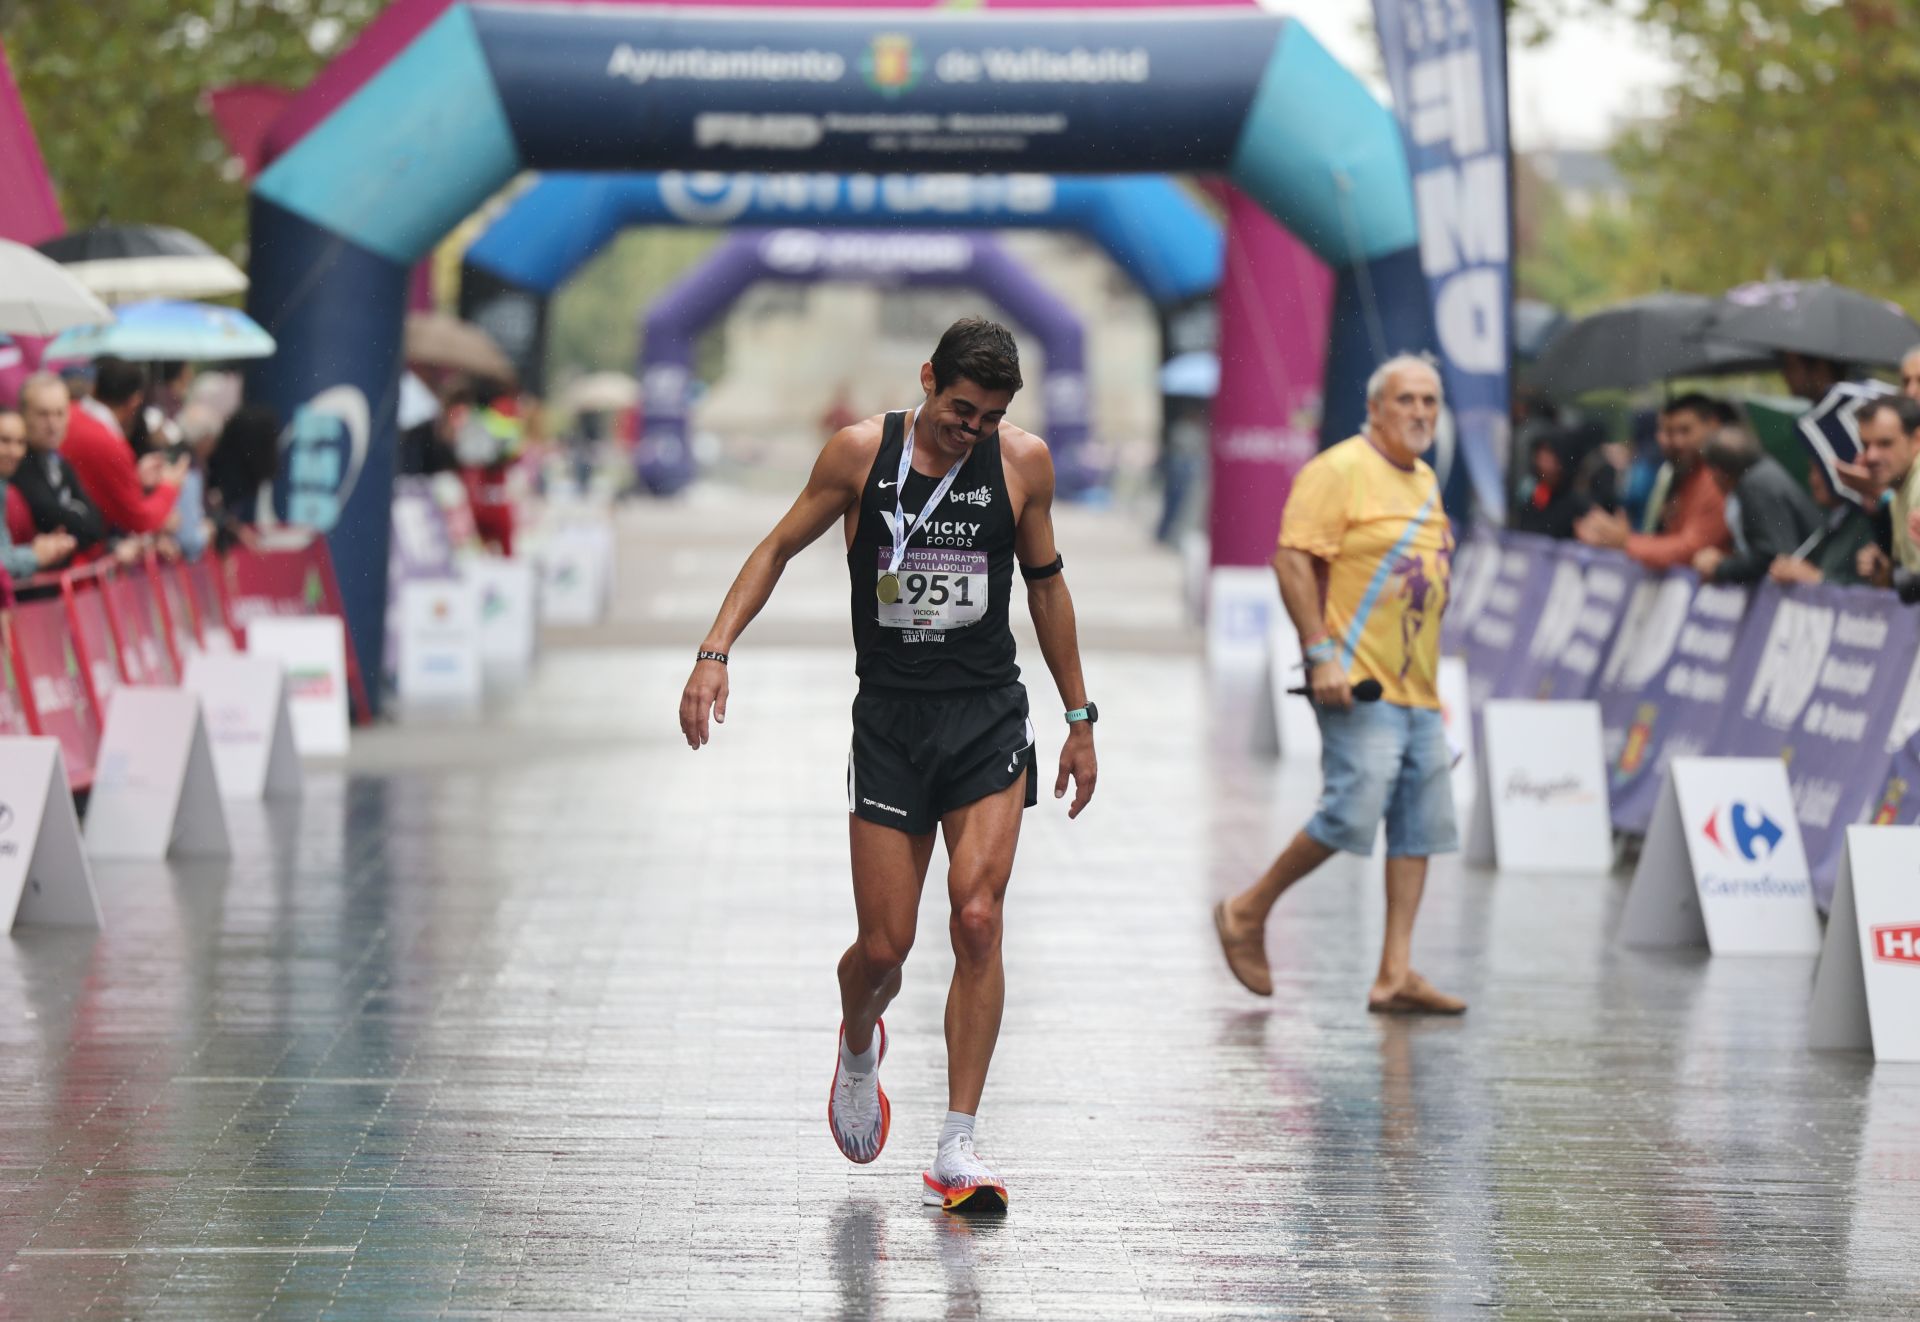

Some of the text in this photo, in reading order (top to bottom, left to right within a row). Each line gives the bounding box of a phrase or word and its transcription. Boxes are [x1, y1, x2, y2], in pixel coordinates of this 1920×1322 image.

[607, 44, 845, 84] Ayuntamiento
[935, 49, 1149, 83] de Valladolid
[950, 485, 992, 507] be plus
[922, 521, 981, 537] VICKY
[926, 537, 973, 548] FOODS
[907, 552, 938, 560] MEDIA
[900, 562, 973, 573] DE VALLADOLID
[895, 573, 974, 607] 951
[1882, 930, 1920, 957] H
